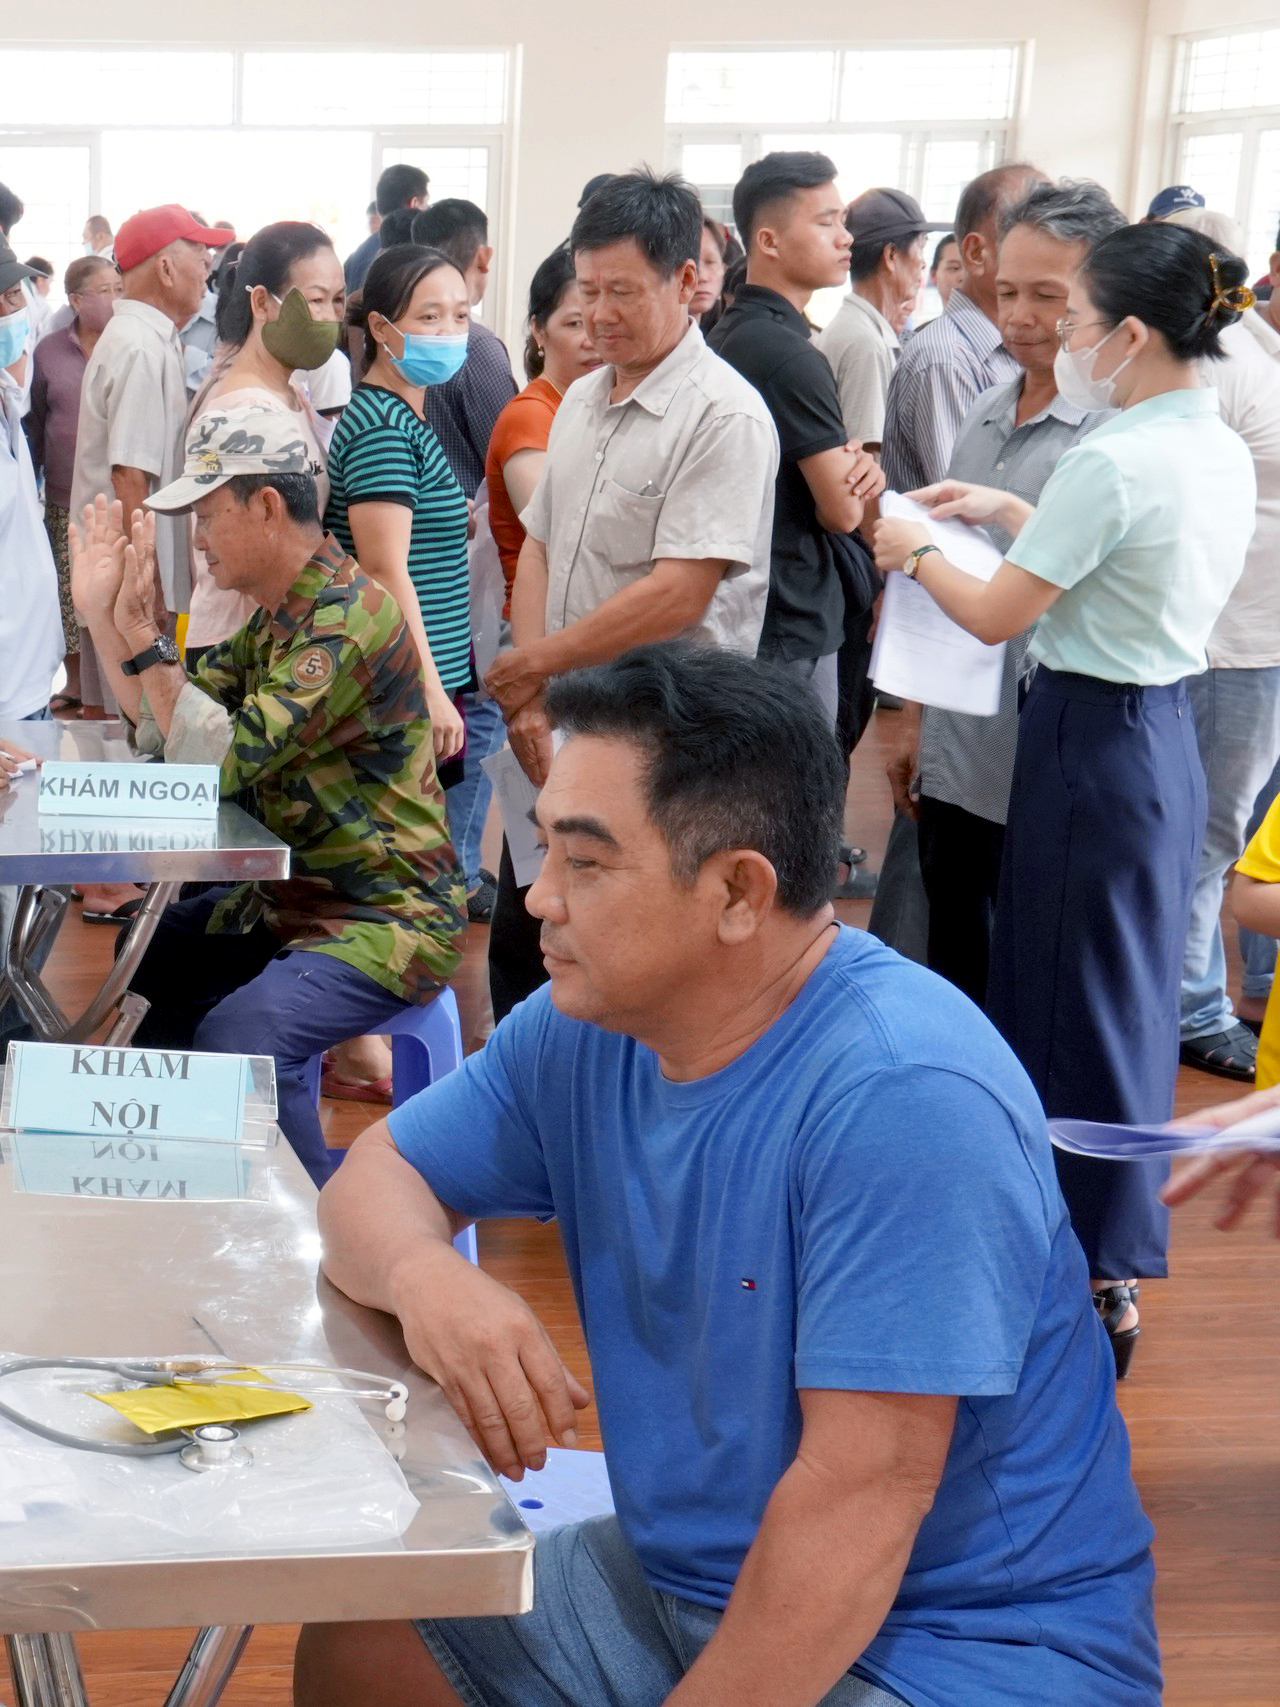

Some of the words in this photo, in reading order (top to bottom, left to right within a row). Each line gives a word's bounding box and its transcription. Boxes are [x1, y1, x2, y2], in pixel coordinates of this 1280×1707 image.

[305, 657, 321, 676] 5
[40, 773, 120, 798] KHÁM
[129, 780, 218, 807] NGOẠI
[88, 1098, 161, 1135] NỘI
